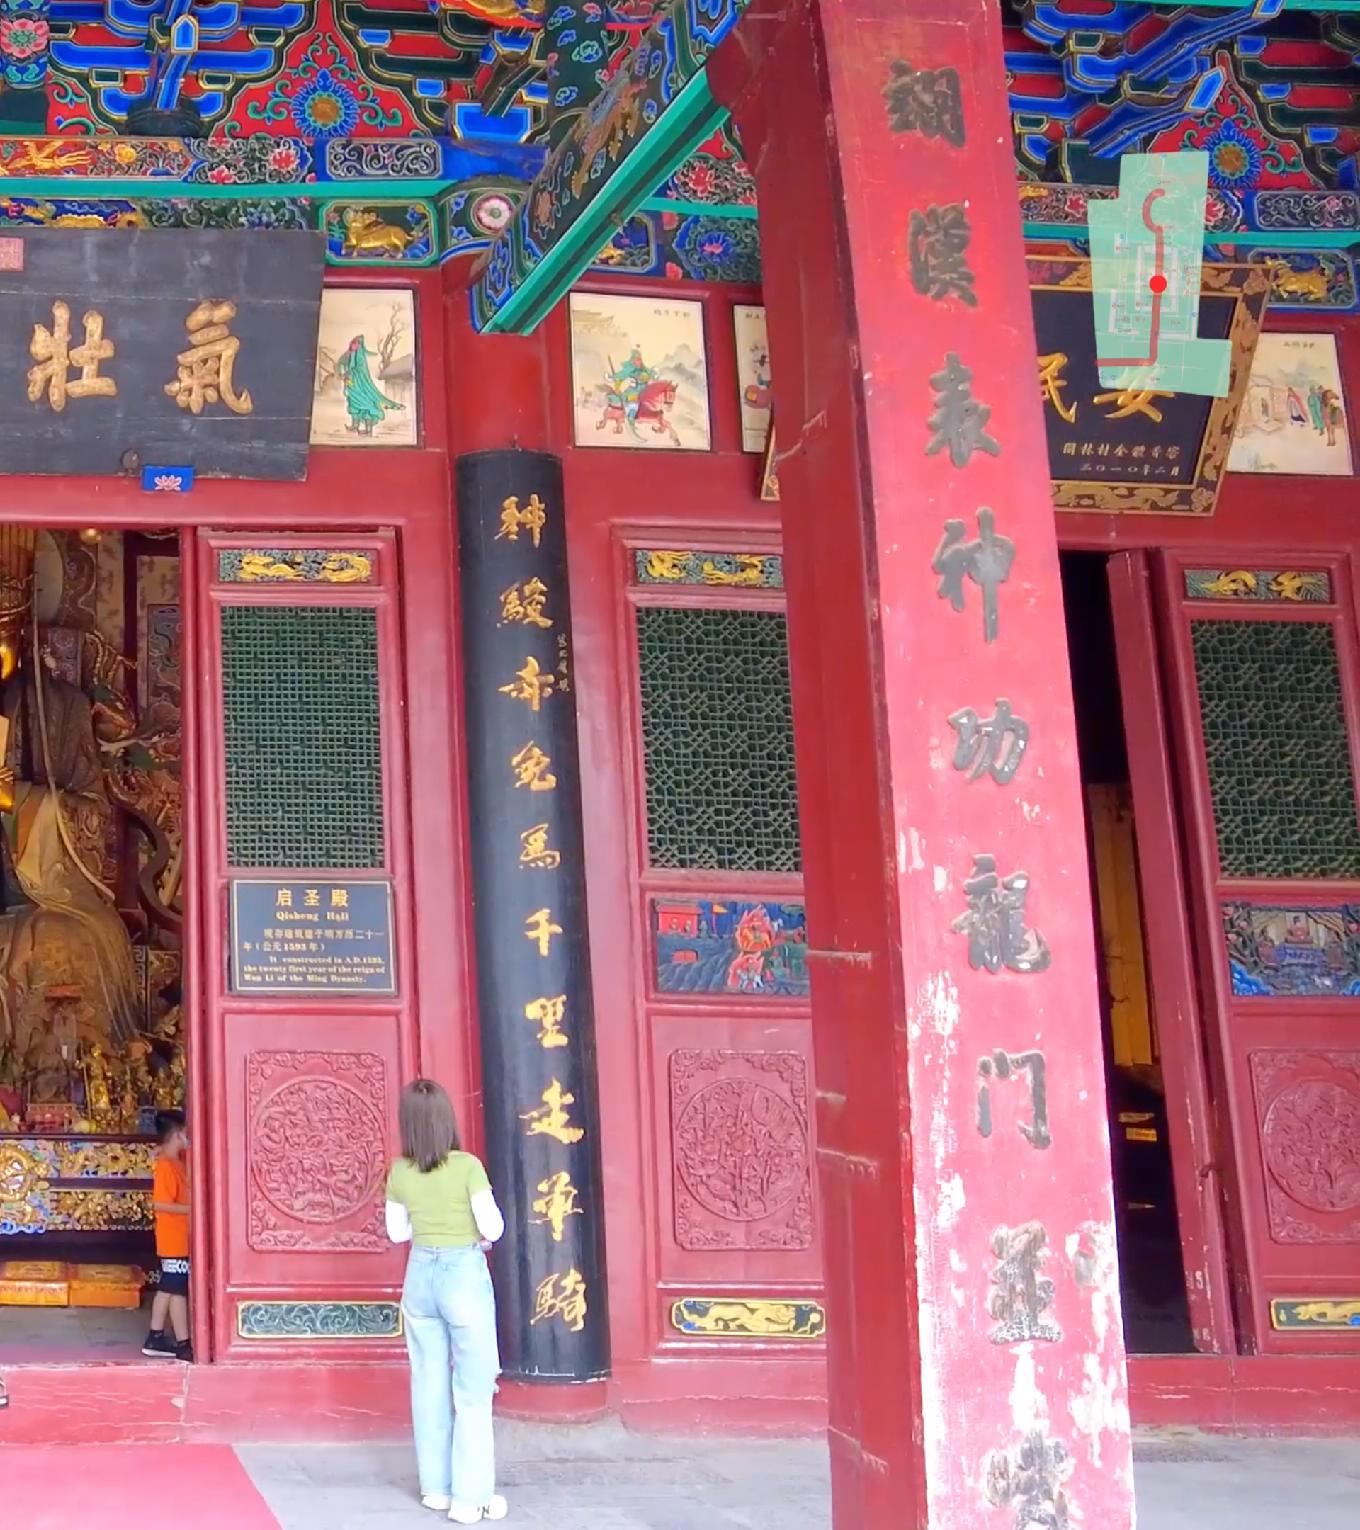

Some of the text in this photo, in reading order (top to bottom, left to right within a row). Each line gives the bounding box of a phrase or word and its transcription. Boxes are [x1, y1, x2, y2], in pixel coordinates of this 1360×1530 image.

[276, 888, 349, 907] 启圣殿
[326, 911, 350, 921] Hall
